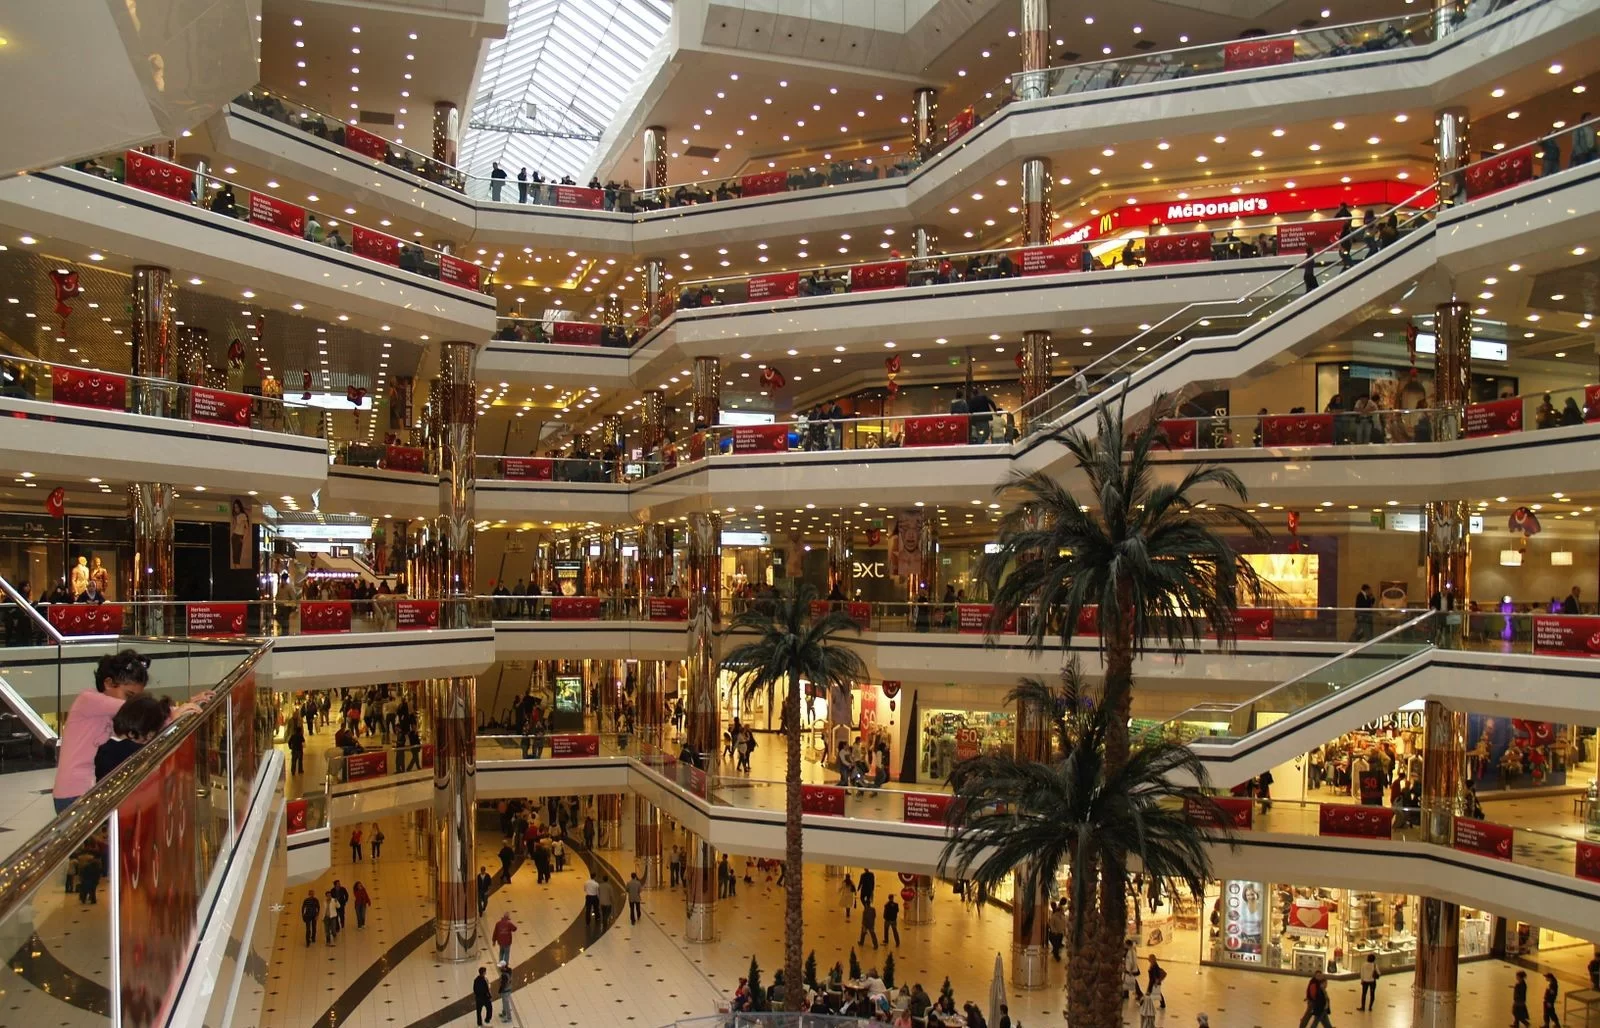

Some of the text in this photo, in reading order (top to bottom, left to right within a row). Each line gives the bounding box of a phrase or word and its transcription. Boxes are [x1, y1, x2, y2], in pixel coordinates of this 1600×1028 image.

[1167, 198, 1268, 219] McDonald's
[852, 562, 884, 578] ext
[1361, 710, 1424, 731] OPSHO
[962, 729, 977, 743] 50
[1228, 952, 1256, 961] Tefal
